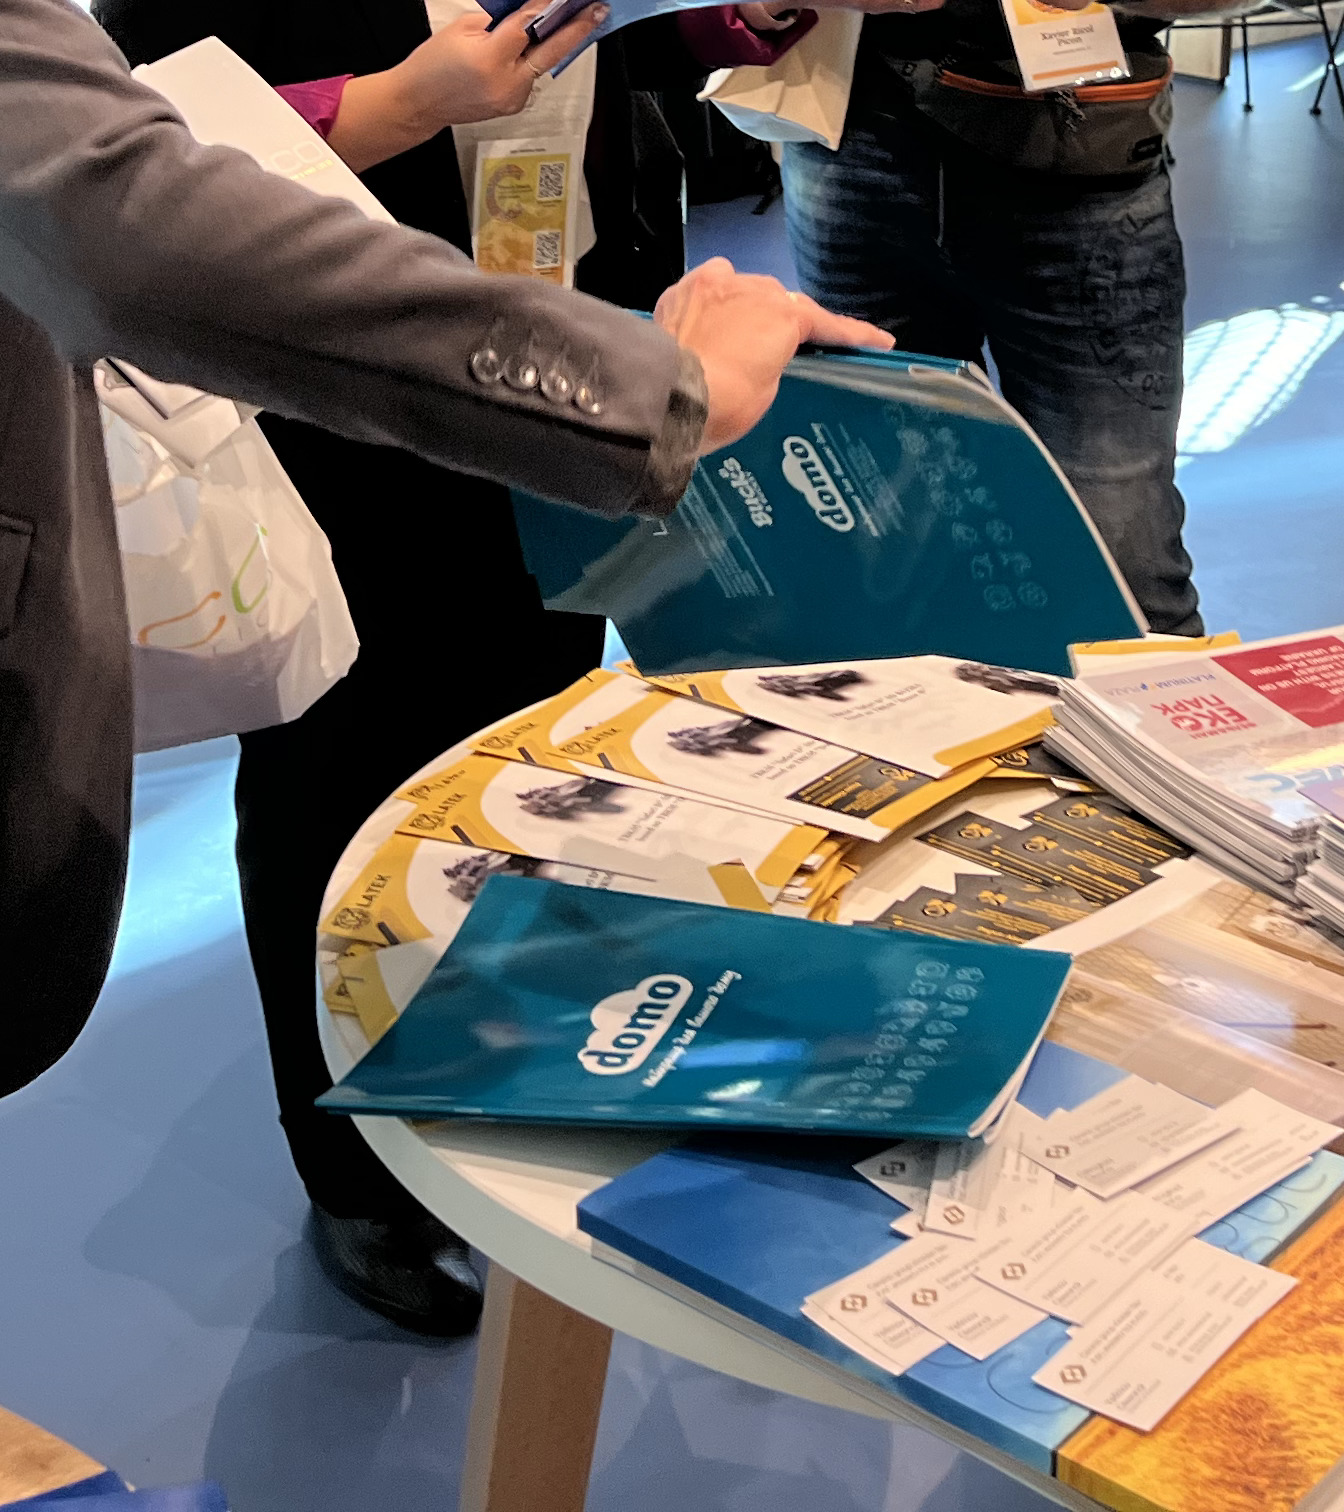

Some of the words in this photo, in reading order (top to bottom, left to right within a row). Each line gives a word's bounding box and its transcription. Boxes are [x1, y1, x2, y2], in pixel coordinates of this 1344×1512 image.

[1150, 693, 1226, 716] ПАРК
[591, 727, 623, 744] LATEK
[433, 792, 466, 817] LATEK
[357, 874, 392, 909] LATEK
[583, 980, 681, 1067] domo
